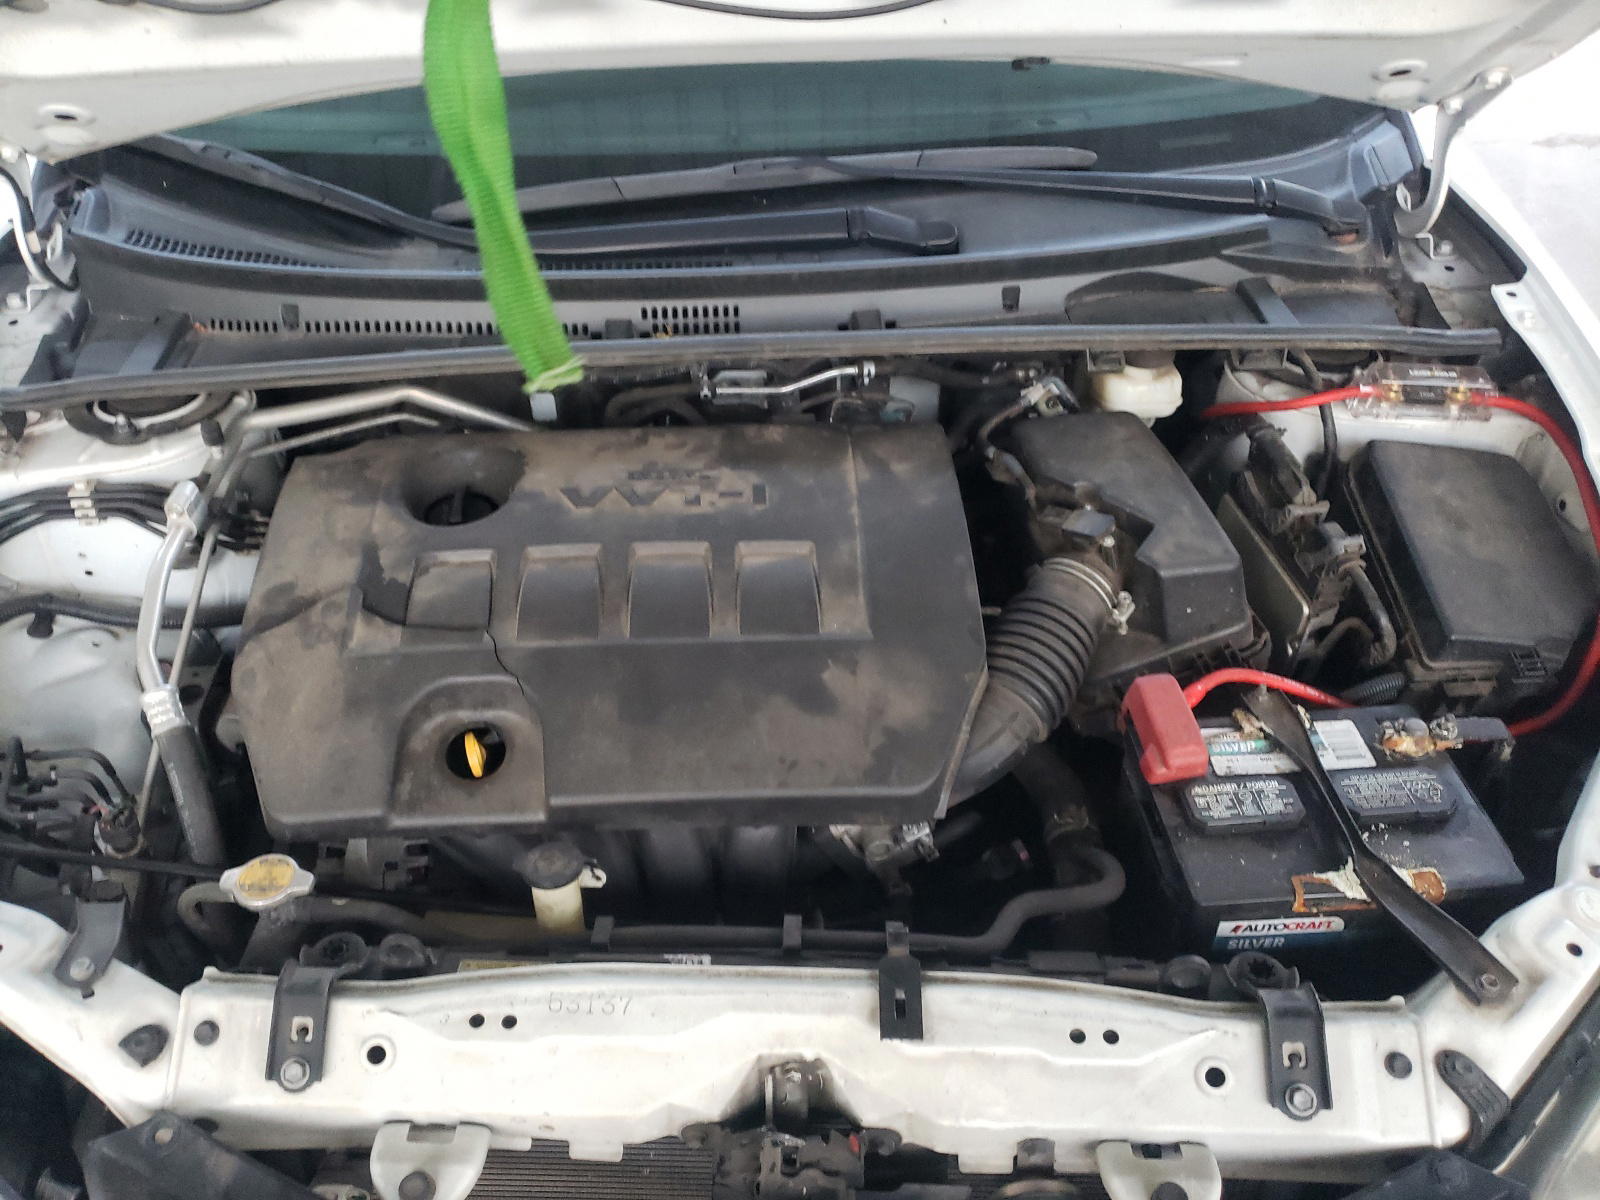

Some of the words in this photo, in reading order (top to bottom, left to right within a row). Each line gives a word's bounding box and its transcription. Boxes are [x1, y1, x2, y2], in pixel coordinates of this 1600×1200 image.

[1246, 779, 1279, 790] POISON
[1241, 920, 1335, 934] AUTOCRAFT
[1227, 937, 1286, 950] SILVER
